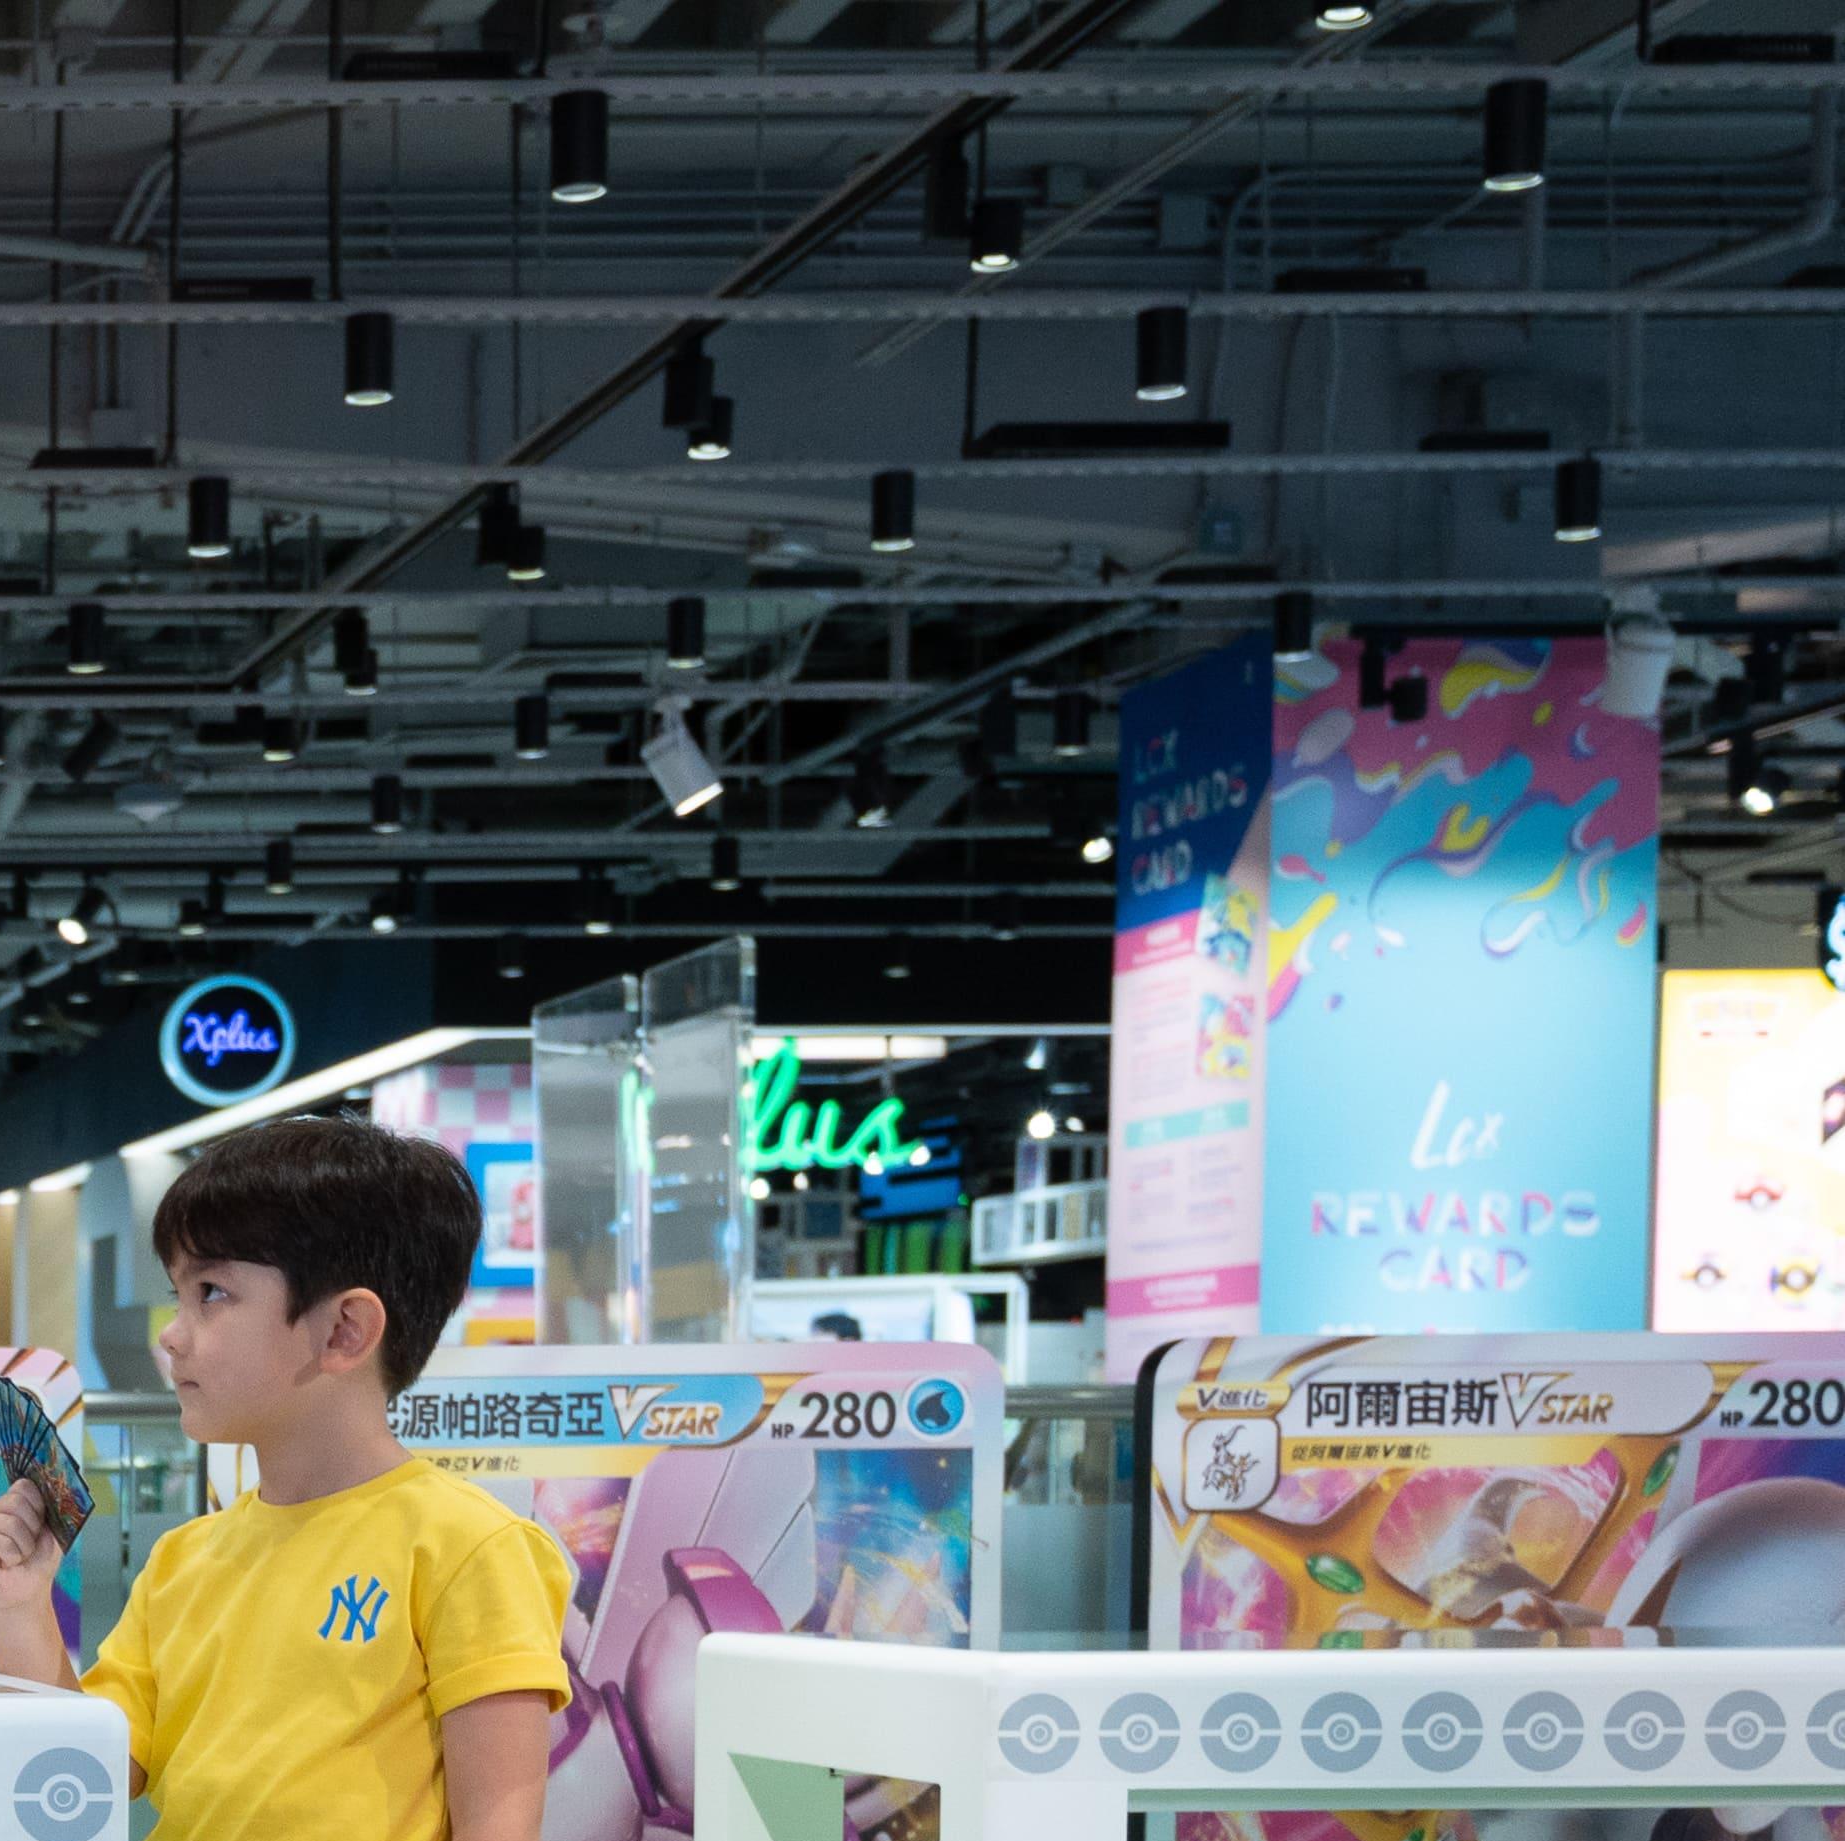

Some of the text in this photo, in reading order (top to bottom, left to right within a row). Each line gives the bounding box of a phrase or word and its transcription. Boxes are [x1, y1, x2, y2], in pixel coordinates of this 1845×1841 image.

[183, 1009, 279, 1067] Xplus
[1310, 1191, 1601, 1238] REWARDS
[1379, 1248, 1530, 1292] CARD
[771, 1422, 794, 1438] HP
[799, 1391, 897, 1438] 280
[1306, 1380, 1498, 1428] 阿爾宙斯
[1720, 1411, 1744, 1426] HP
[1749, 1379, 1845, 1426] 280
